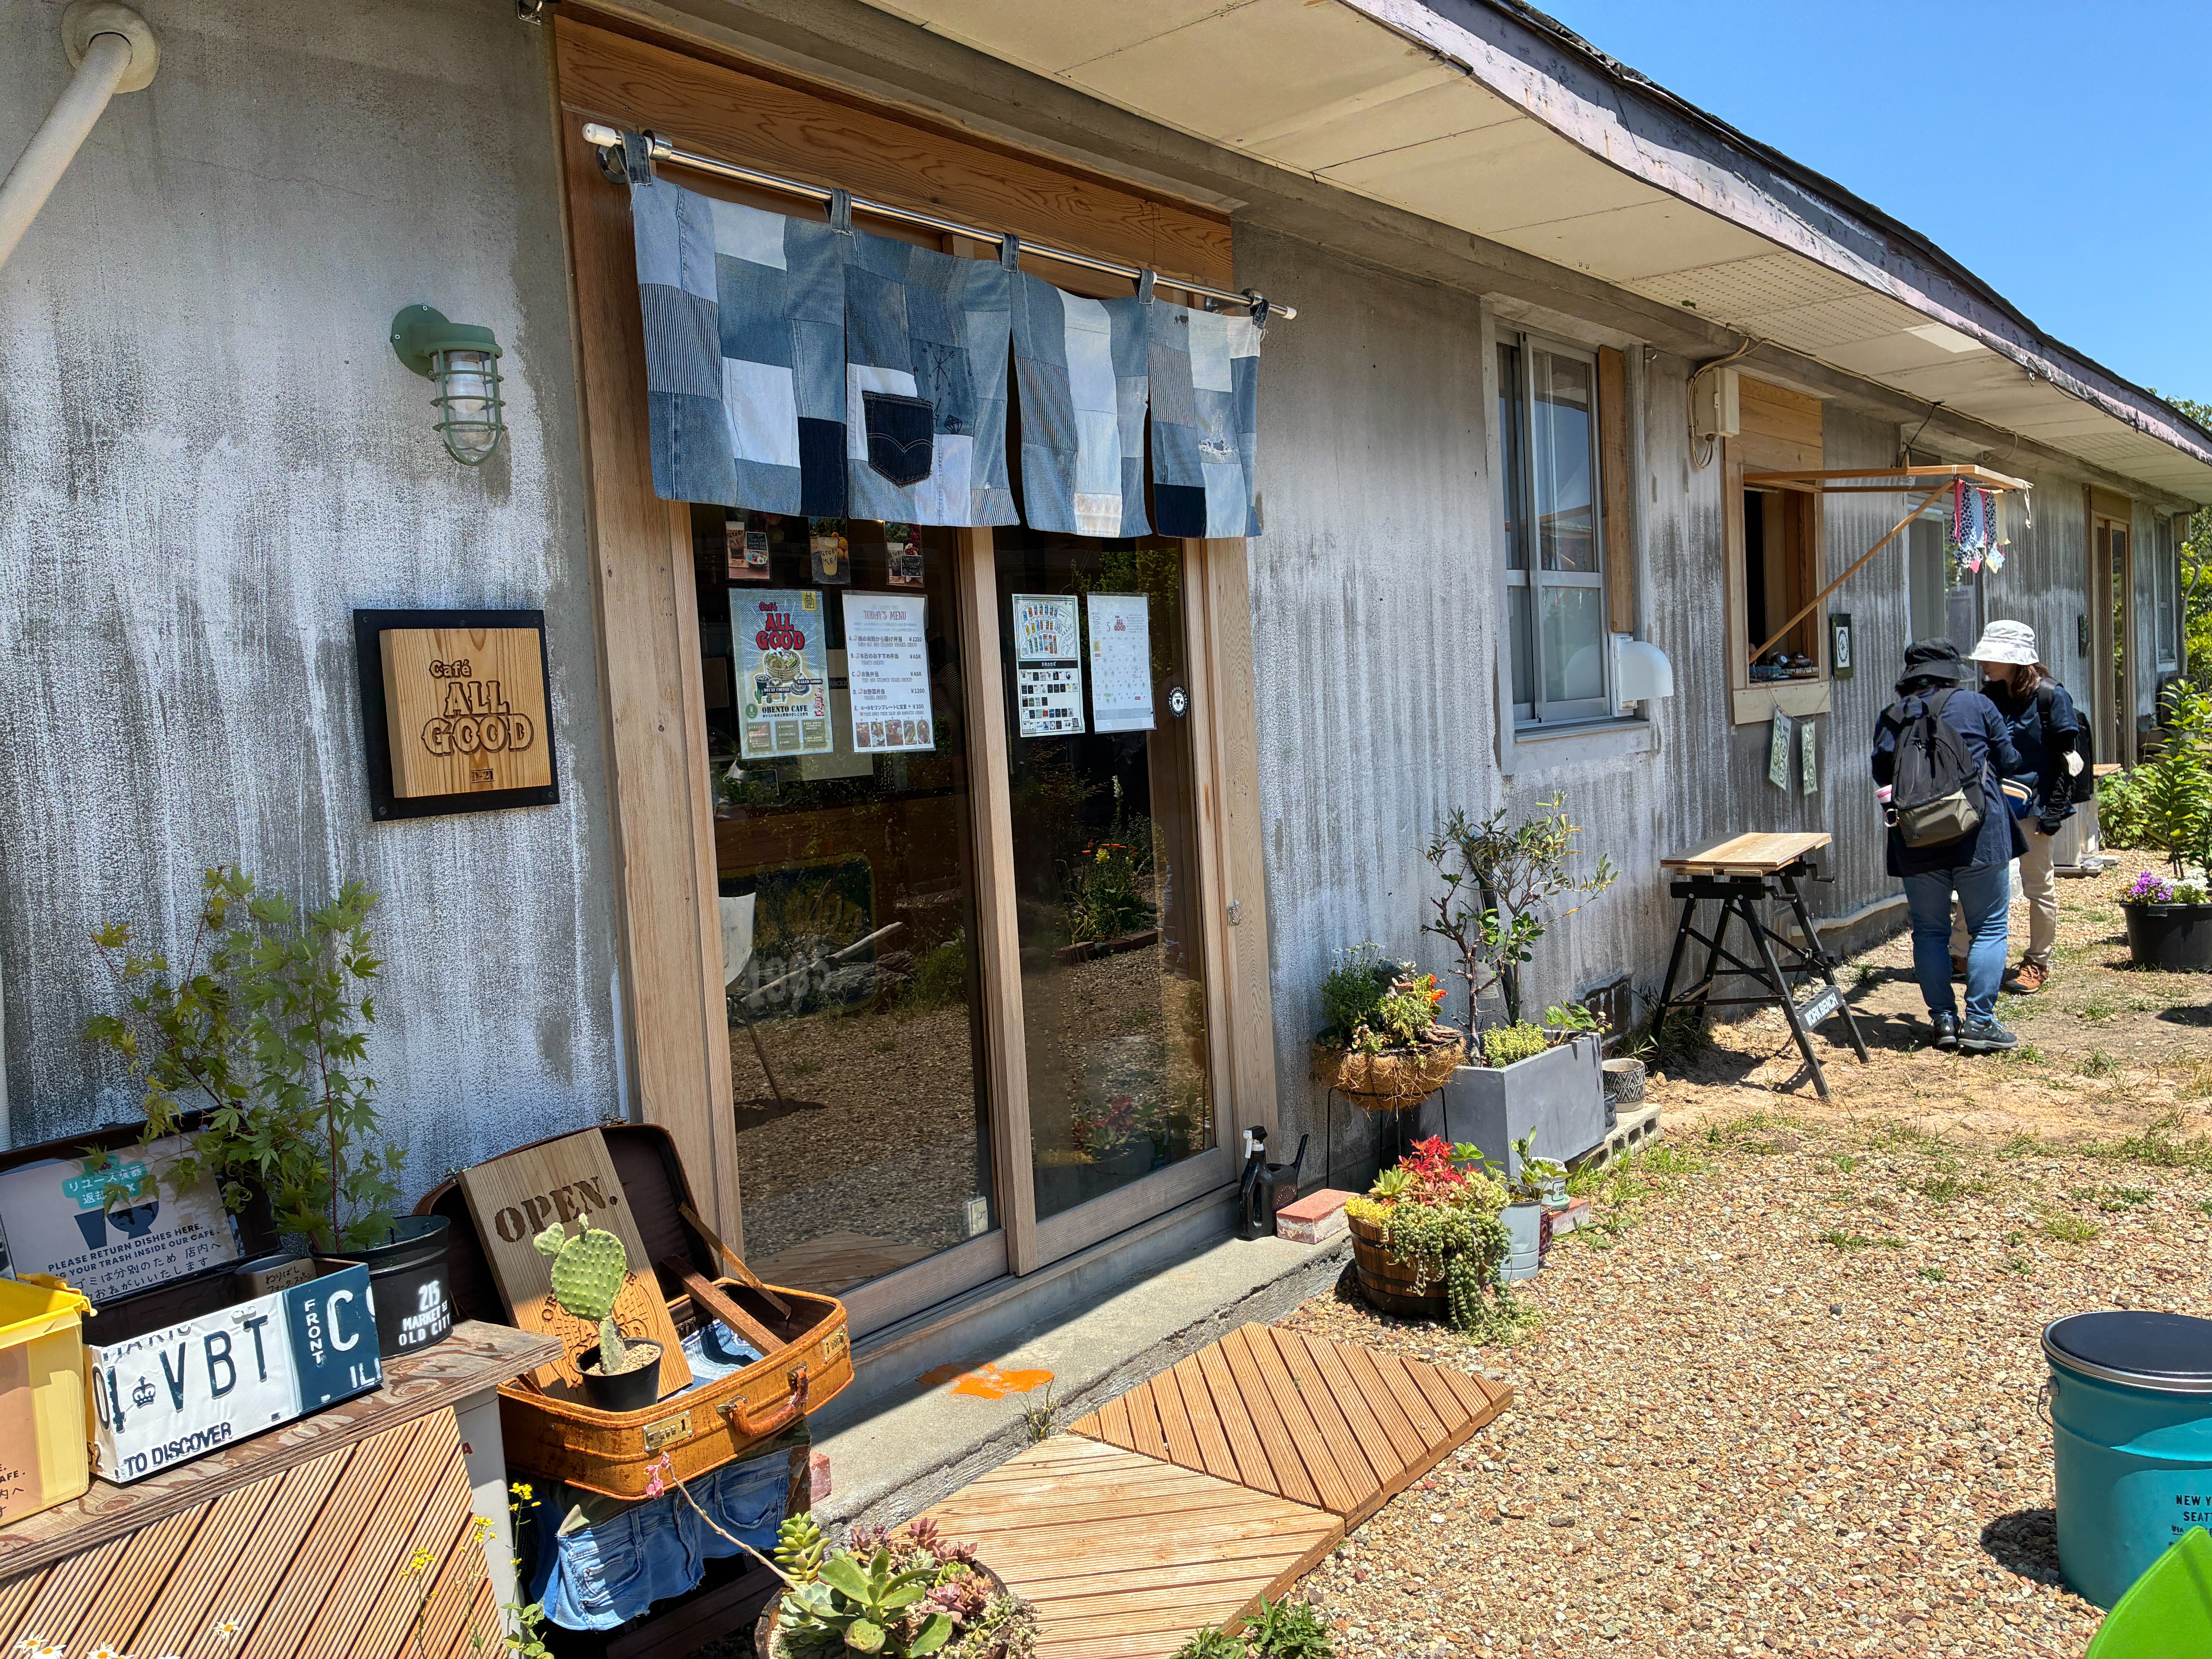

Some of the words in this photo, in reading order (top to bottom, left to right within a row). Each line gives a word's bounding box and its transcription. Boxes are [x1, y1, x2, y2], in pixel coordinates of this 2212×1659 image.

[759, 601, 778, 611] Café
[765, 613, 794, 631] ALL
[864, 610, 887, 620] TODAY'S
[890, 611, 906, 620] MENU
[756, 630, 805, 650] GOOD
[429, 659, 472, 678] Café
[443, 680, 510, 718] ALL
[762, 705, 789, 713] OBENTO
[421, 714, 534, 757] GOOD
[495, 1176, 618, 1243] OPEN.
[48, 1255, 88, 1272] PLEASE
[91, 1242, 132, 1260] RETURN
[135, 1231, 172, 1247] DISHES
[174, 1223, 203, 1236] HERE.
[70, 1263, 97, 1276] YOUR
[99, 1253, 131, 1268] TRASH
[134, 1243, 167, 1257] INSIDE
[169, 1237, 188, 1247] OUR
[75, 1253, 176, 1289] ゴミは分別のため
[185, 1243, 221, 1259] 店内へ
[418, 1279, 441, 1311] 215
[304, 1298, 325, 1364] FRONT
[398, 1328, 426, 1346] OLD
[431, 1312, 450, 1335] CITY
[402, 1305, 441, 1331] MARKET
[123, 1452, 147, 1477] TO
[151, 1422, 232, 1465] DISCOVER
[2176, 1494, 2201, 1506] NEW
